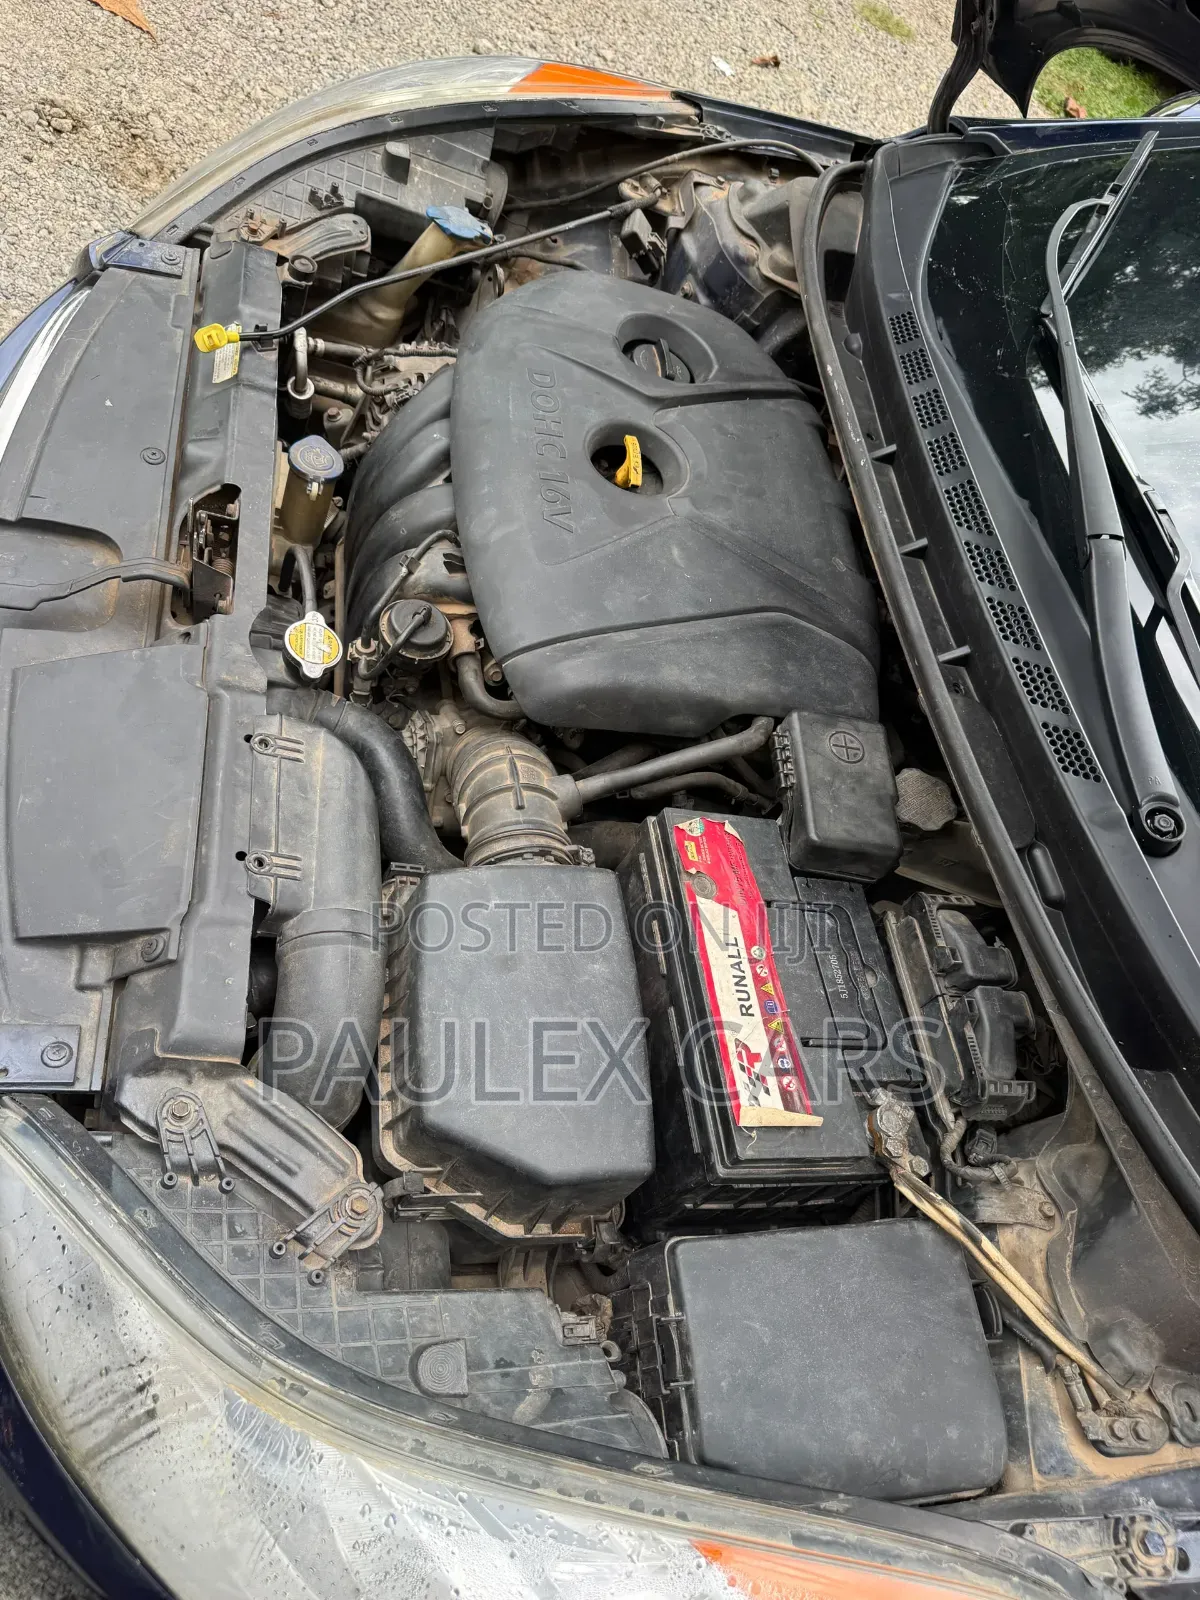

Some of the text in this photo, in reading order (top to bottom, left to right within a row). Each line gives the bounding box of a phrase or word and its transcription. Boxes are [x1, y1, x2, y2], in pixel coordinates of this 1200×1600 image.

[527, 367, 574, 534] DOHC 16V
[726, 937, 755, 1017] RUNALL
